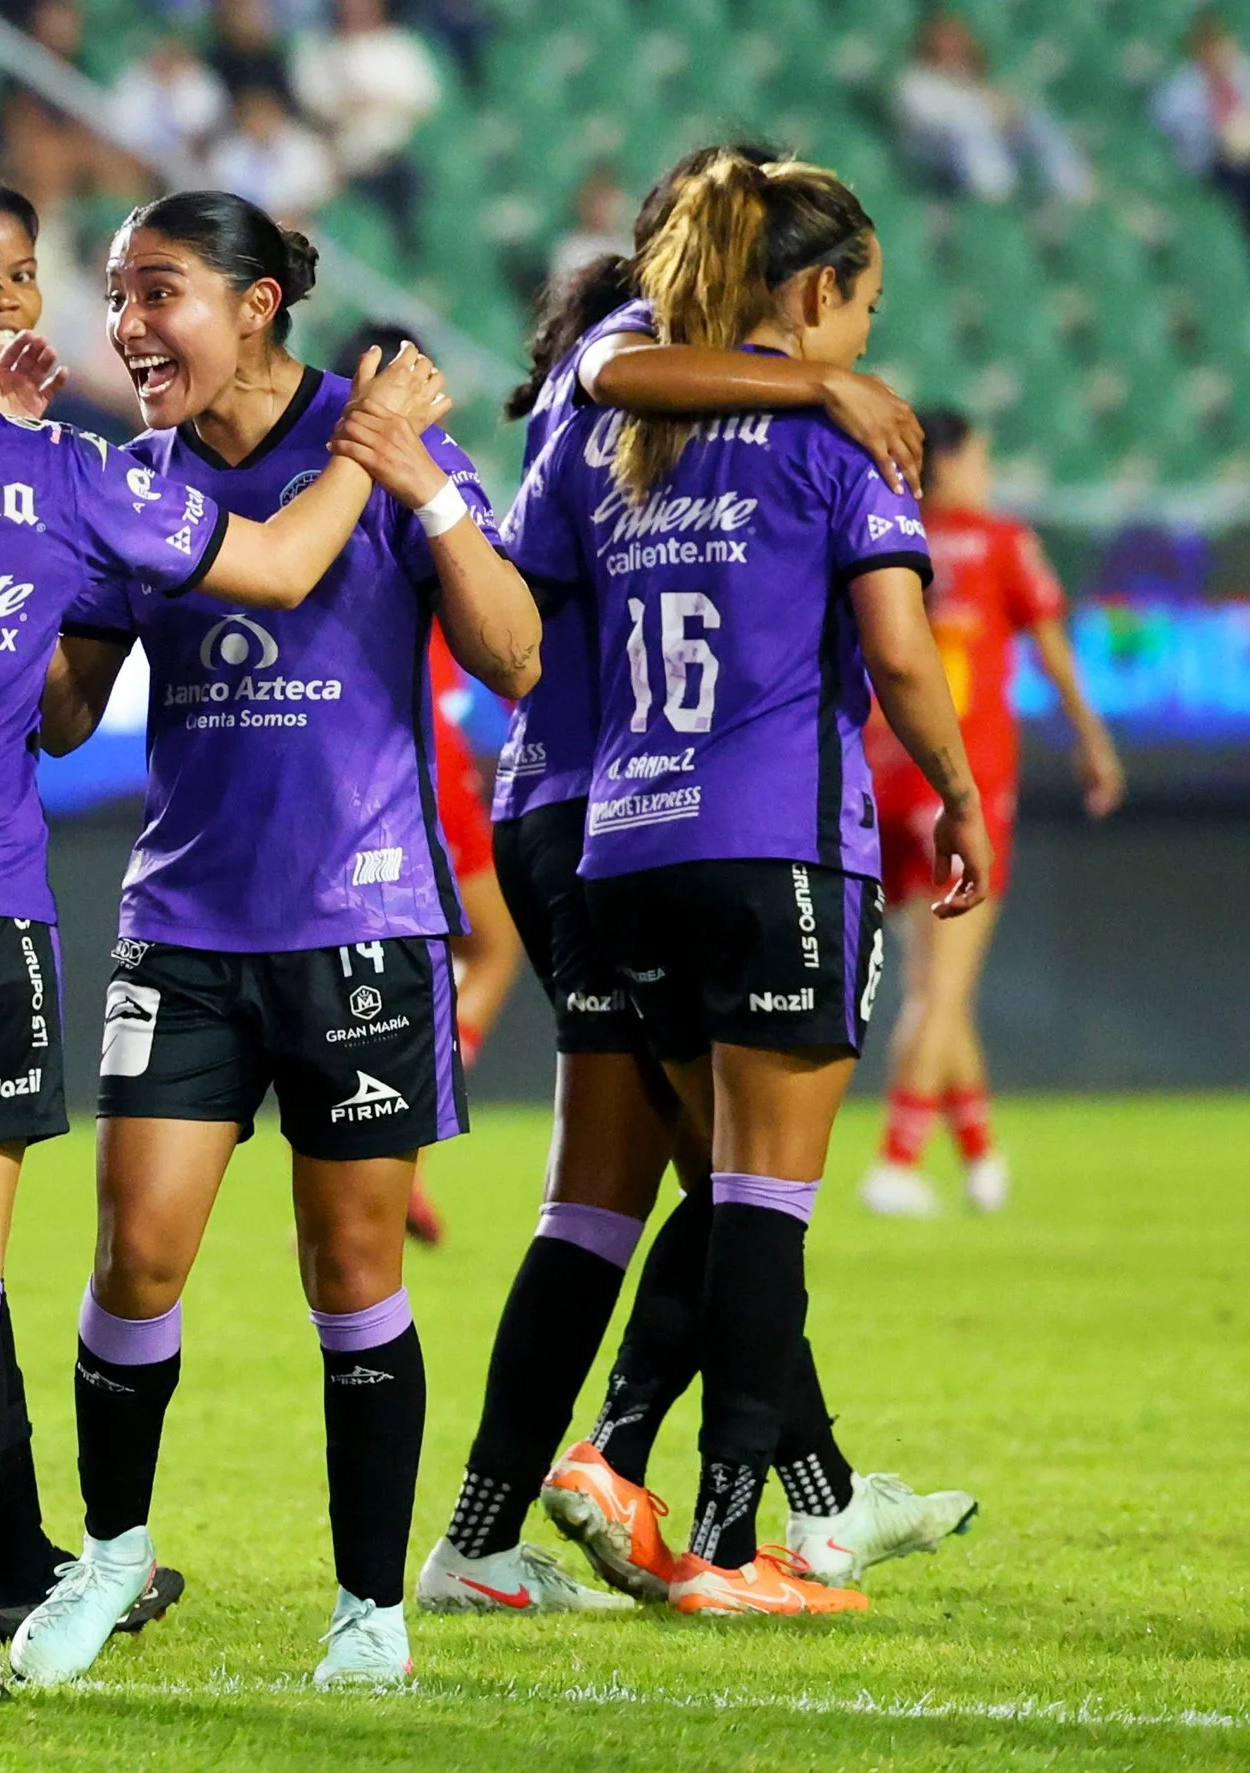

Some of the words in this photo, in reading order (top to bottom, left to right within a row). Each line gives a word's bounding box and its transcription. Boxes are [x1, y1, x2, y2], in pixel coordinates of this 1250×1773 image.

[606, 536, 748, 577] caliente.mx
[626, 591, 721, 734] 16
[234, 675, 343, 701] Azteca
[239, 709, 309, 728] Somos
[791, 863, 816, 932] GRUPO
[801, 935, 821, 969] STI
[21, 936, 43, 1011] GRUPO
[749, 987, 814, 1013] Nazil
[31, 1015, 49, 1048] STI
[326, 1025, 367, 1042] GRAN
[369, 1014, 410, 1035] MARÍA
[330, 1097, 410, 1123] PIRMA
